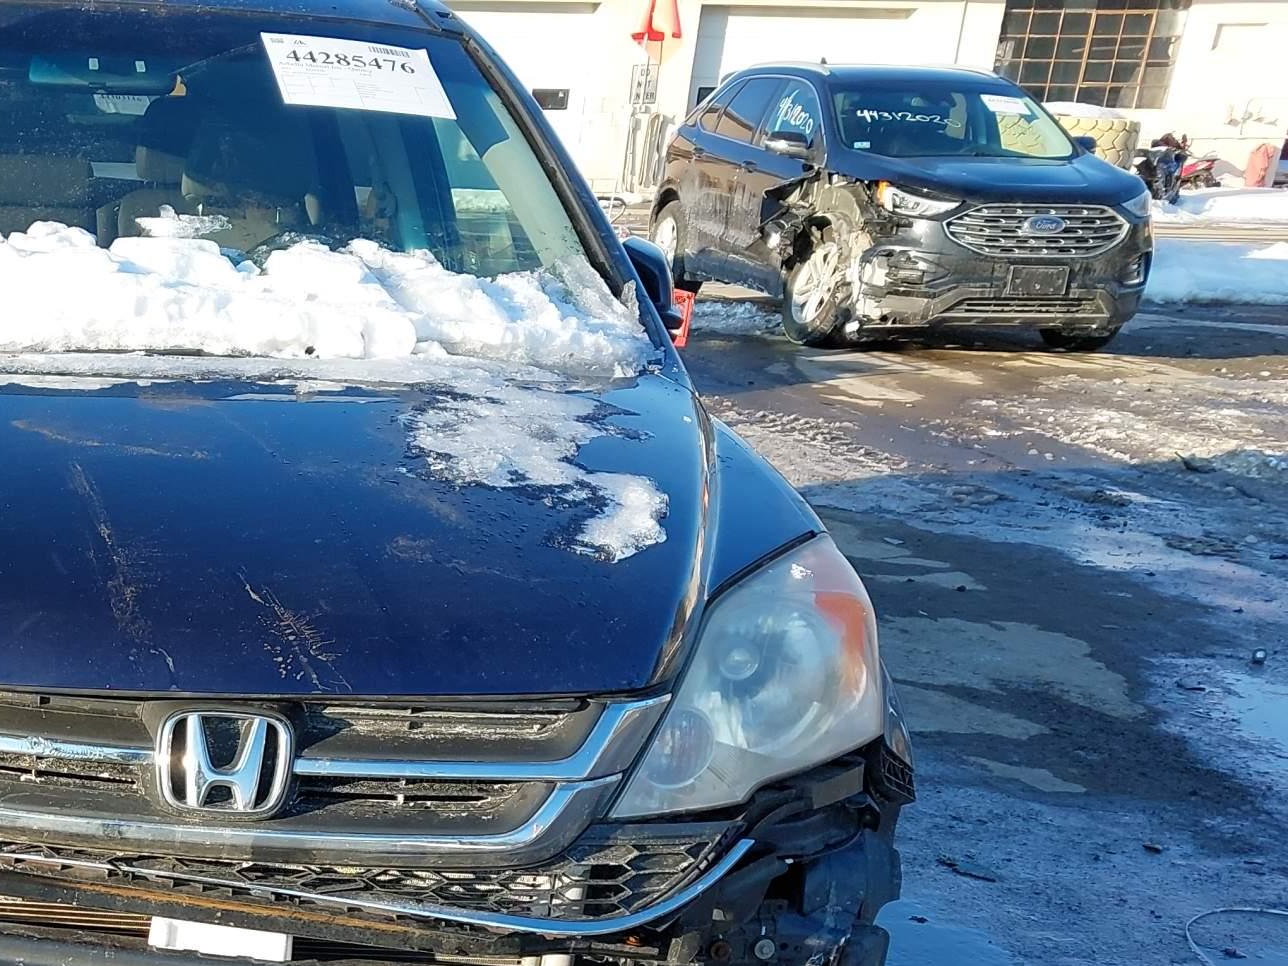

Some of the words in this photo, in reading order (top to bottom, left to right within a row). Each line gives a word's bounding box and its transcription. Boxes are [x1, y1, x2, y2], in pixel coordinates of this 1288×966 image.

[285, 49, 415, 74] 44285476
[636, 79, 653, 89] NT
[856, 109, 961, 127] 44312020
